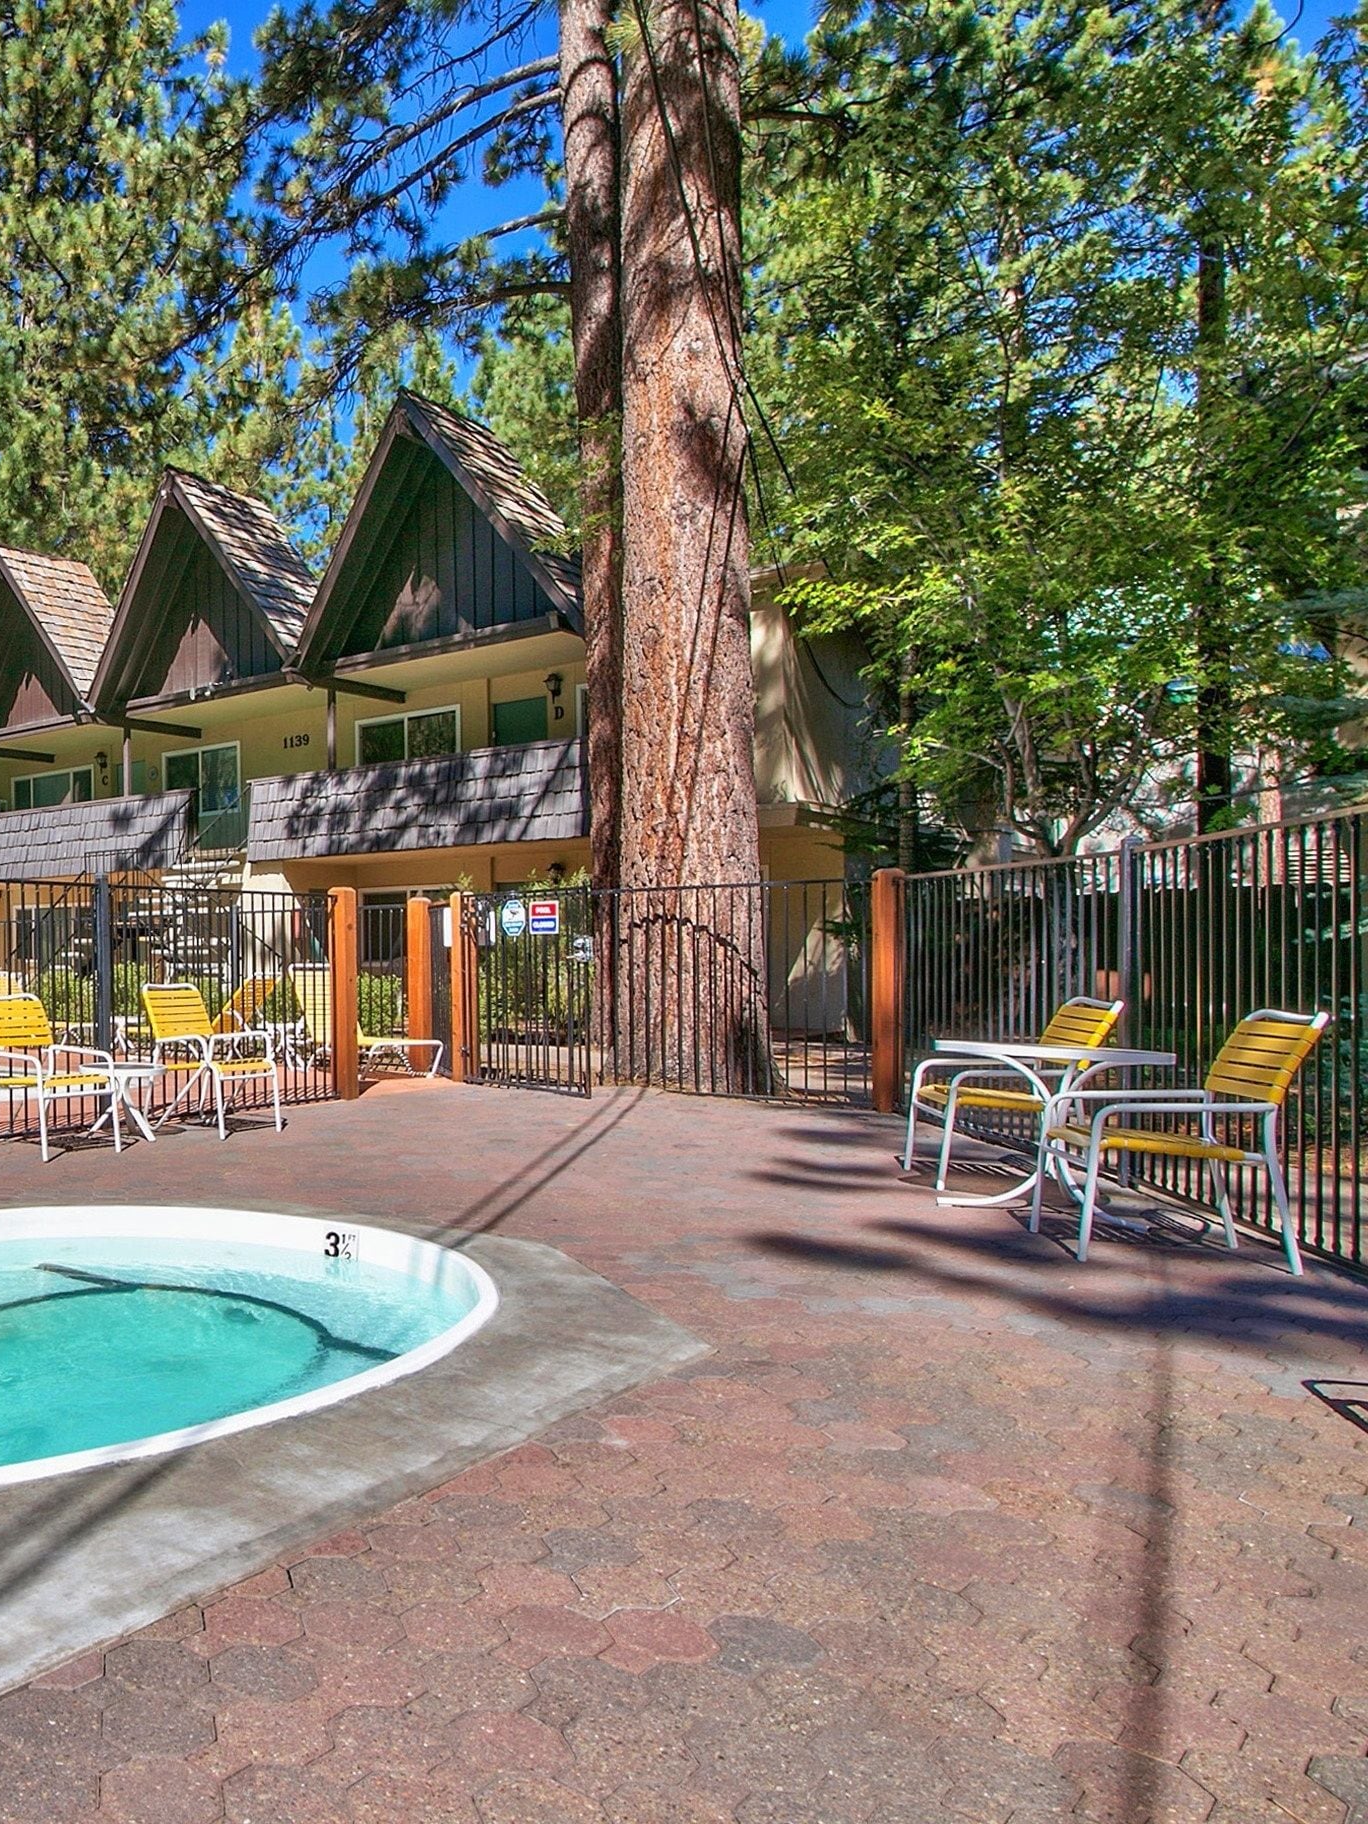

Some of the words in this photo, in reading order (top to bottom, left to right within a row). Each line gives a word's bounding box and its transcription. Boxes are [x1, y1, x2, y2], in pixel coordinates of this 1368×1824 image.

[554, 705, 565, 720] D
[283, 733, 310, 749] 1139
[101, 775, 109, 786] C
